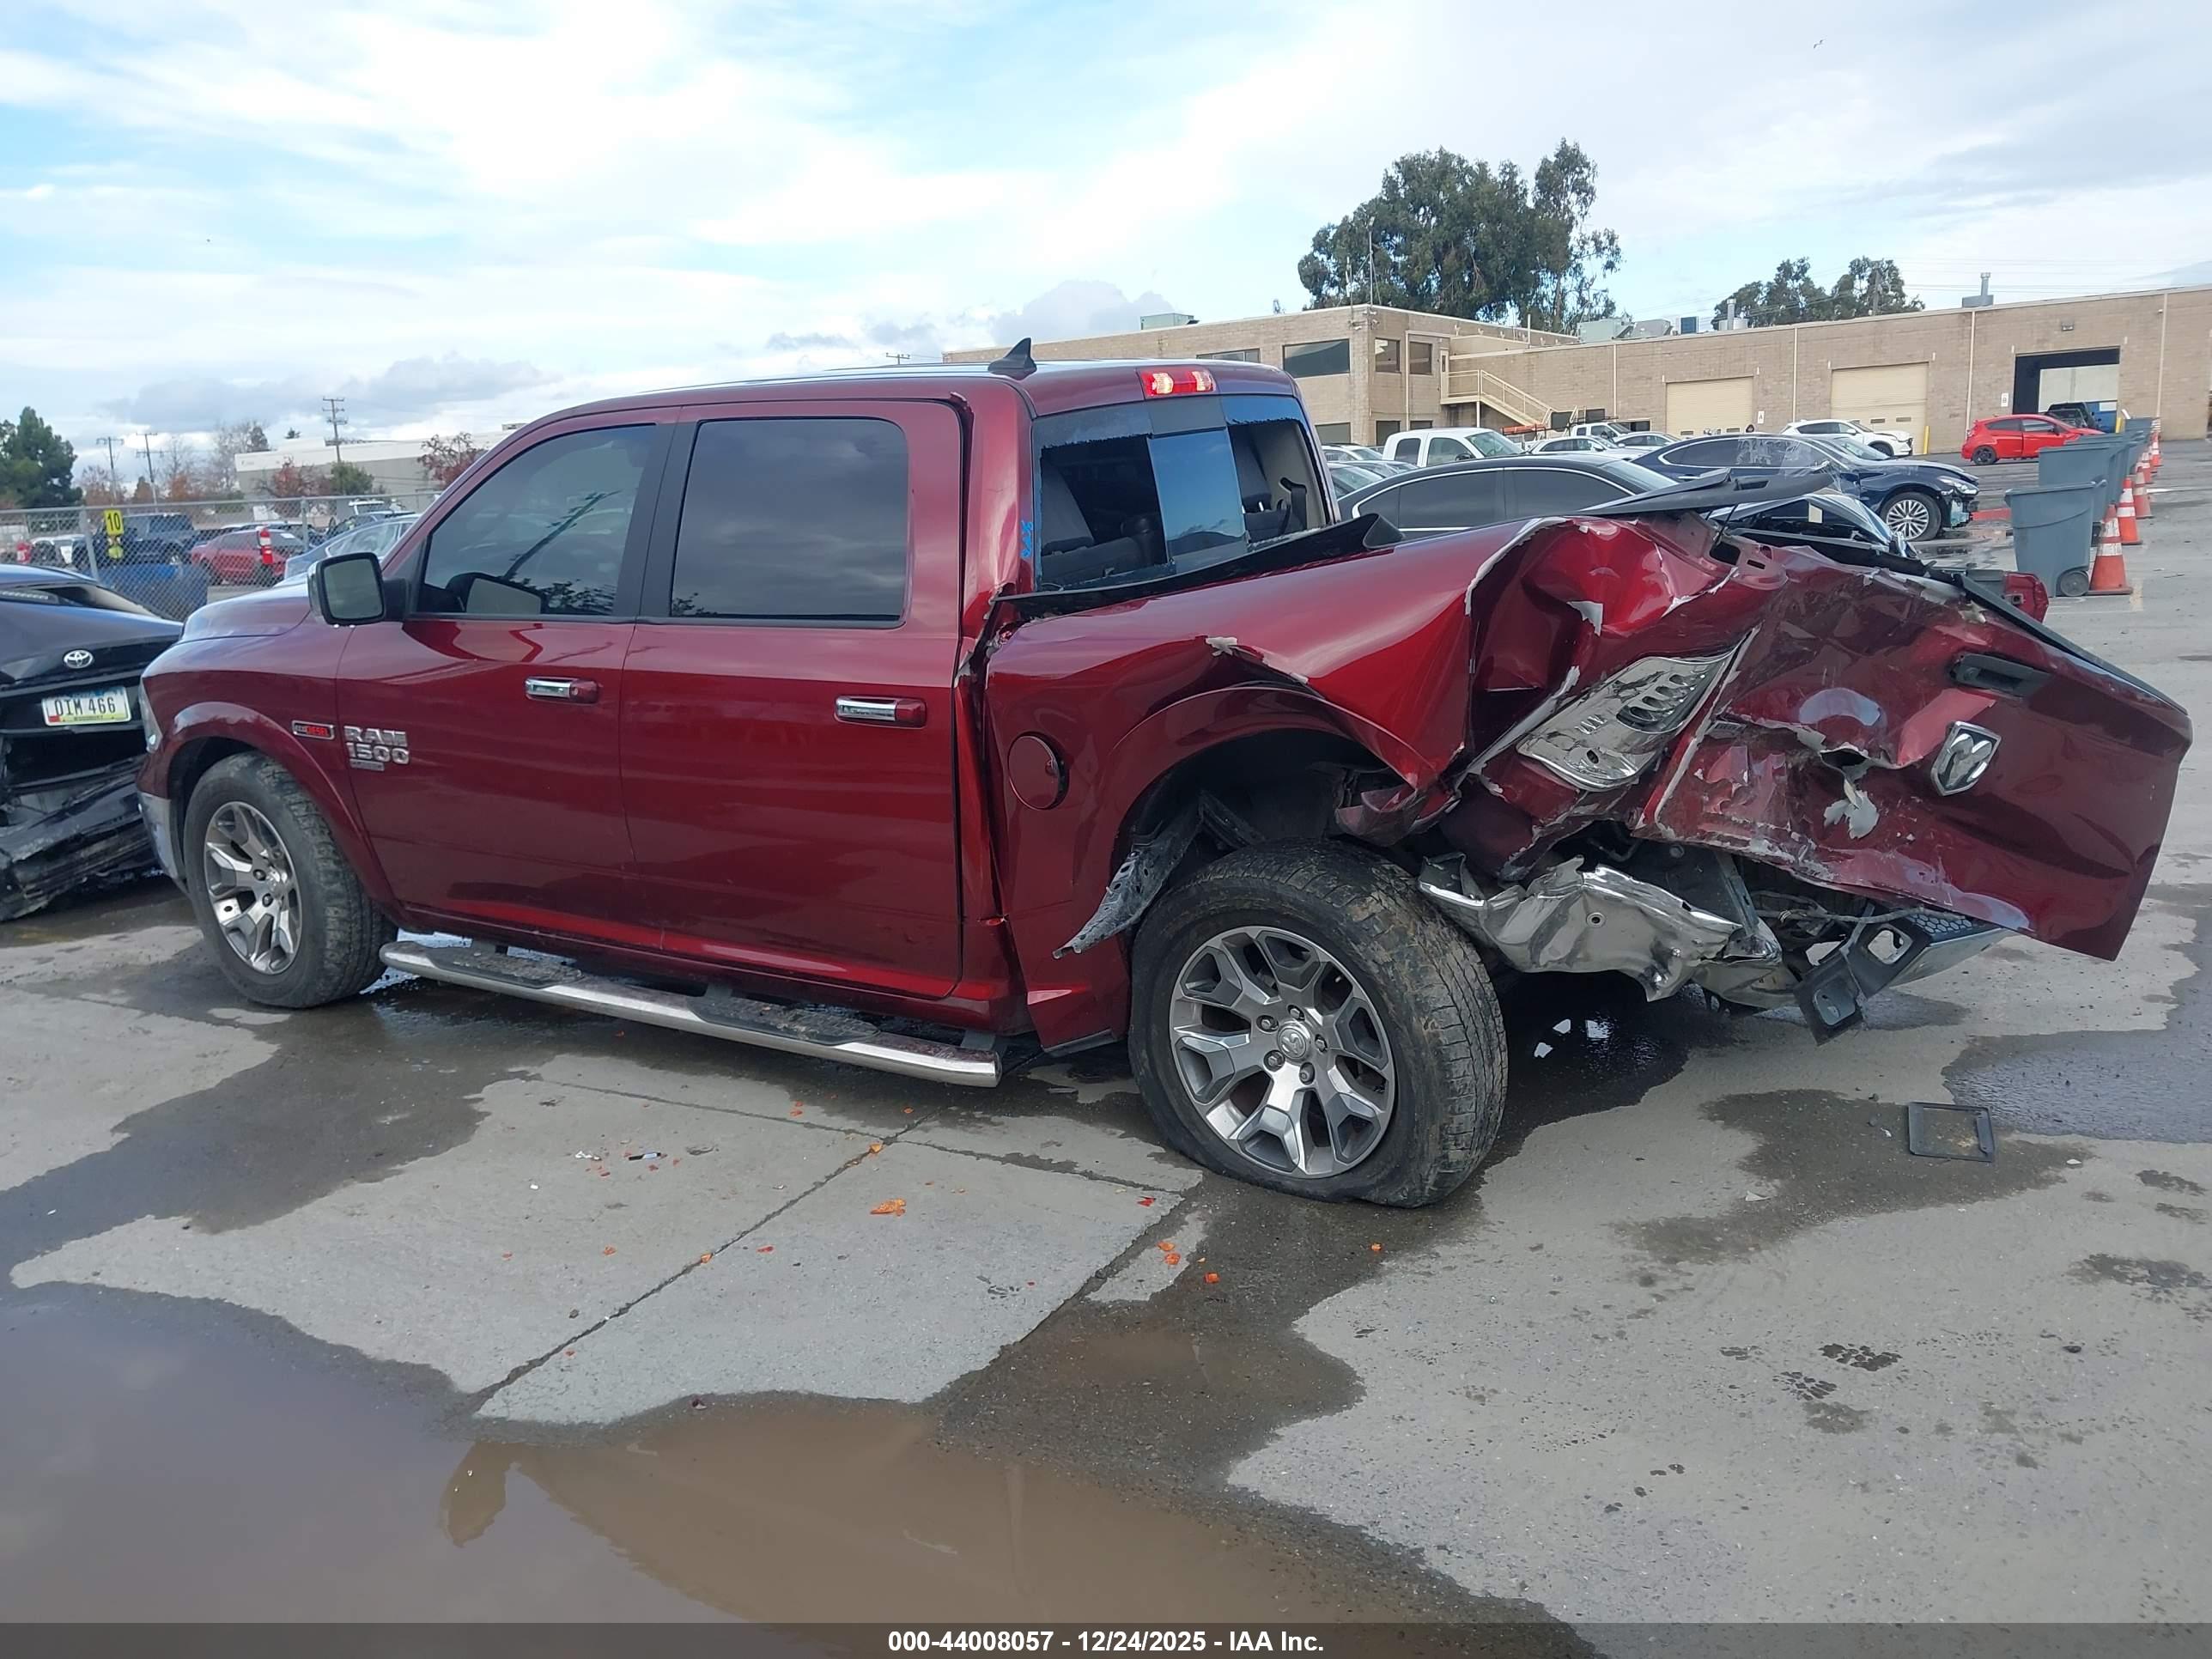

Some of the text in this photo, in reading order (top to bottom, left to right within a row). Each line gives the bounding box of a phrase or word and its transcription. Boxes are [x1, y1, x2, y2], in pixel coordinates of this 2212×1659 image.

[108, 513, 121, 531] 10
[88, 696, 116, 714] 466
[343, 726, 408, 747] RAM
[346, 742, 410, 765] 1500
